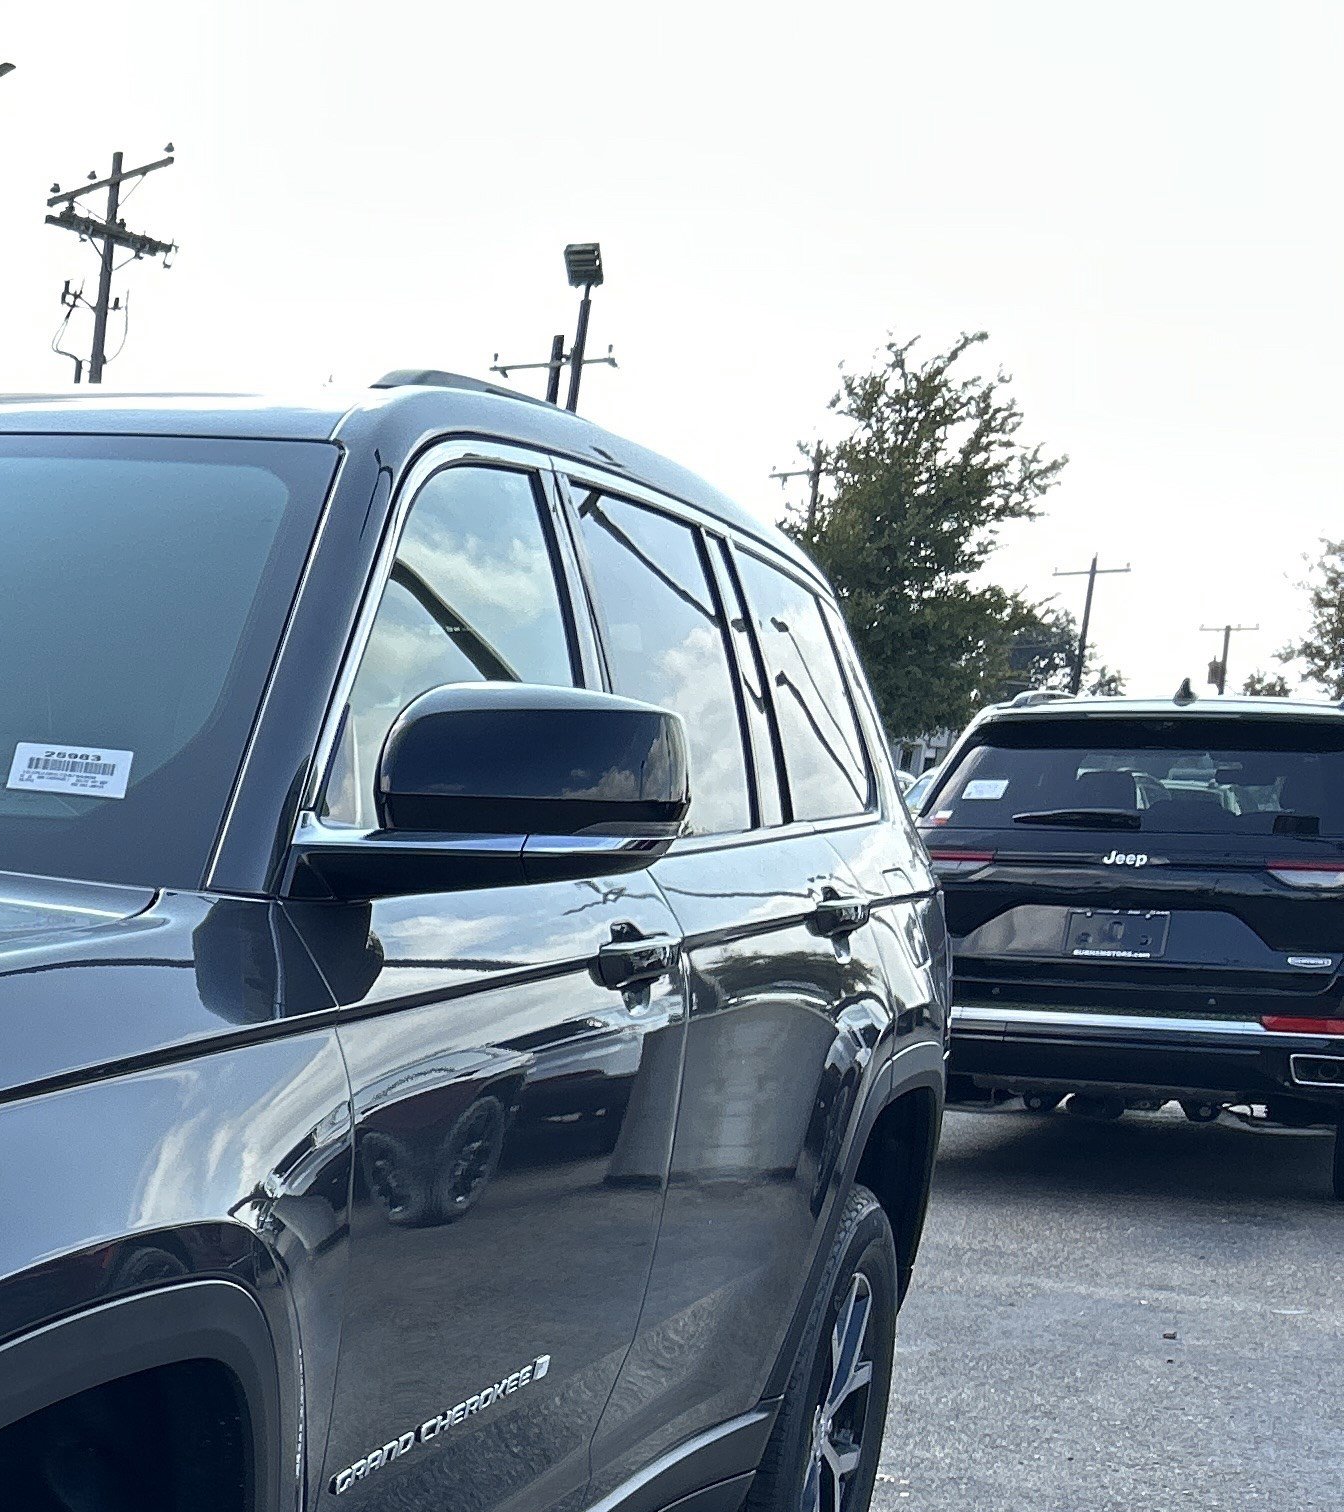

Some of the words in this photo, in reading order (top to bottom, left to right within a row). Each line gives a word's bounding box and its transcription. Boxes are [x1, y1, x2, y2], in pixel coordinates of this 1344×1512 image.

[1102, 850, 1148, 867] Jeep
[329, 1431, 414, 1495] GRAND
[416, 1365, 533, 1443] CHEROKEE
